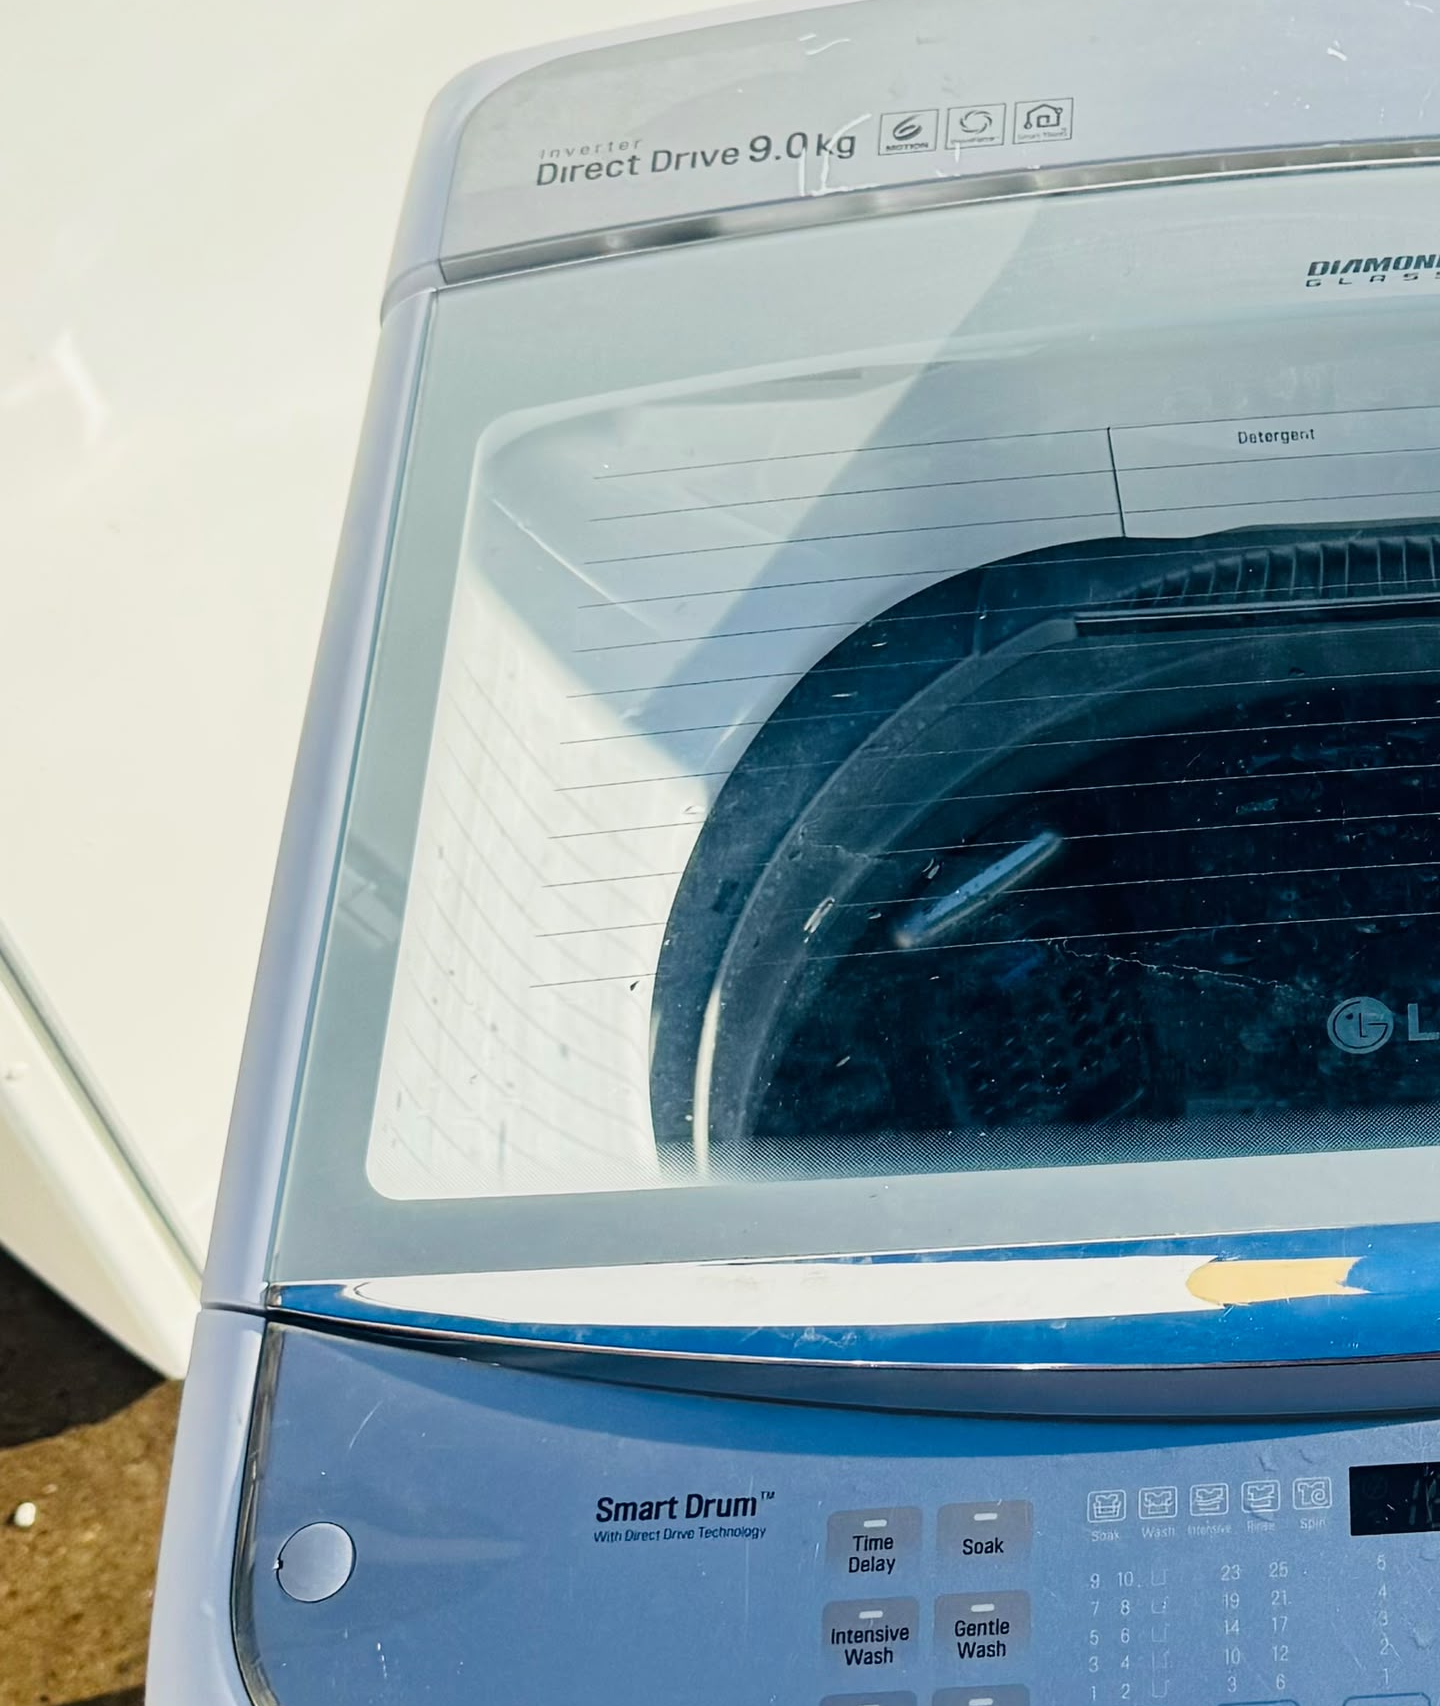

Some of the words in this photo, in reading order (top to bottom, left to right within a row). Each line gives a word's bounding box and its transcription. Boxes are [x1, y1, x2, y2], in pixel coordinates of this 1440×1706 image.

[885, 142, 929, 152] MOTION
[537, 154, 640, 186] Direct
[651, 144, 740, 173] Drive
[749, 132, 808, 162] 9.0
[816, 133, 857, 159] kg
[1238, 428, 1315, 446] Detergent
[596, 1496, 679, 1522] Smart
[1142, 1527, 1176, 1539] Wash
[1300, 1518, 1326, 1530] Spin
[594, 1530, 622, 1543] With
[625, 1529, 661, 1541] Direct
[664, 1528, 694, 1540] Drive
[698, 1526, 766, 1540] Technology
[854, 1535, 894, 1552] Time
[1091, 1530, 1120, 1542] Soak
[962, 1537, 1005, 1555] Soak
[848, 1556, 896, 1575] Delay
[1220, 1564, 1241, 1581] 23
[1269, 1561, 1288, 1578] 25
[1376, 1554, 1386, 1570] 5
[1090, 1573, 1100, 1589] 9
[1117, 1571, 1134, 1587] 10
[1223, 1592, 1240, 1609] 19
[1271, 1590, 1288, 1606] 21
[1378, 1584, 1387, 1598] 4
[1091, 1601, 1099, 1616] 7
[1120, 1599, 1130, 1615] 8
[954, 1618, 1010, 1637] Gentle
[1223, 1619, 1240, 1635] 14
[1271, 1616, 1288, 1632] 17
[1379, 1611, 1388, 1626] 3
[831, 1625, 910, 1645] Intensive
[1089, 1629, 1099, 1645] 5
[1120, 1628, 1130, 1644] 6
[957, 1640, 1006, 1660] Wash
[1380, 1635, 1390, 1655] 2
[845, 1646, 893, 1666] Wash
[1089, 1656, 1099, 1673] 3
[1120, 1654, 1130, 1670] 4
[1224, 1647, 1240, 1665] 10
[1272, 1645, 1289, 1662] 12
[1121, 1683, 1130, 1699] 2
[1228, 1676, 1237, 1693] 3
[1276, 1674, 1286, 1690] 6
